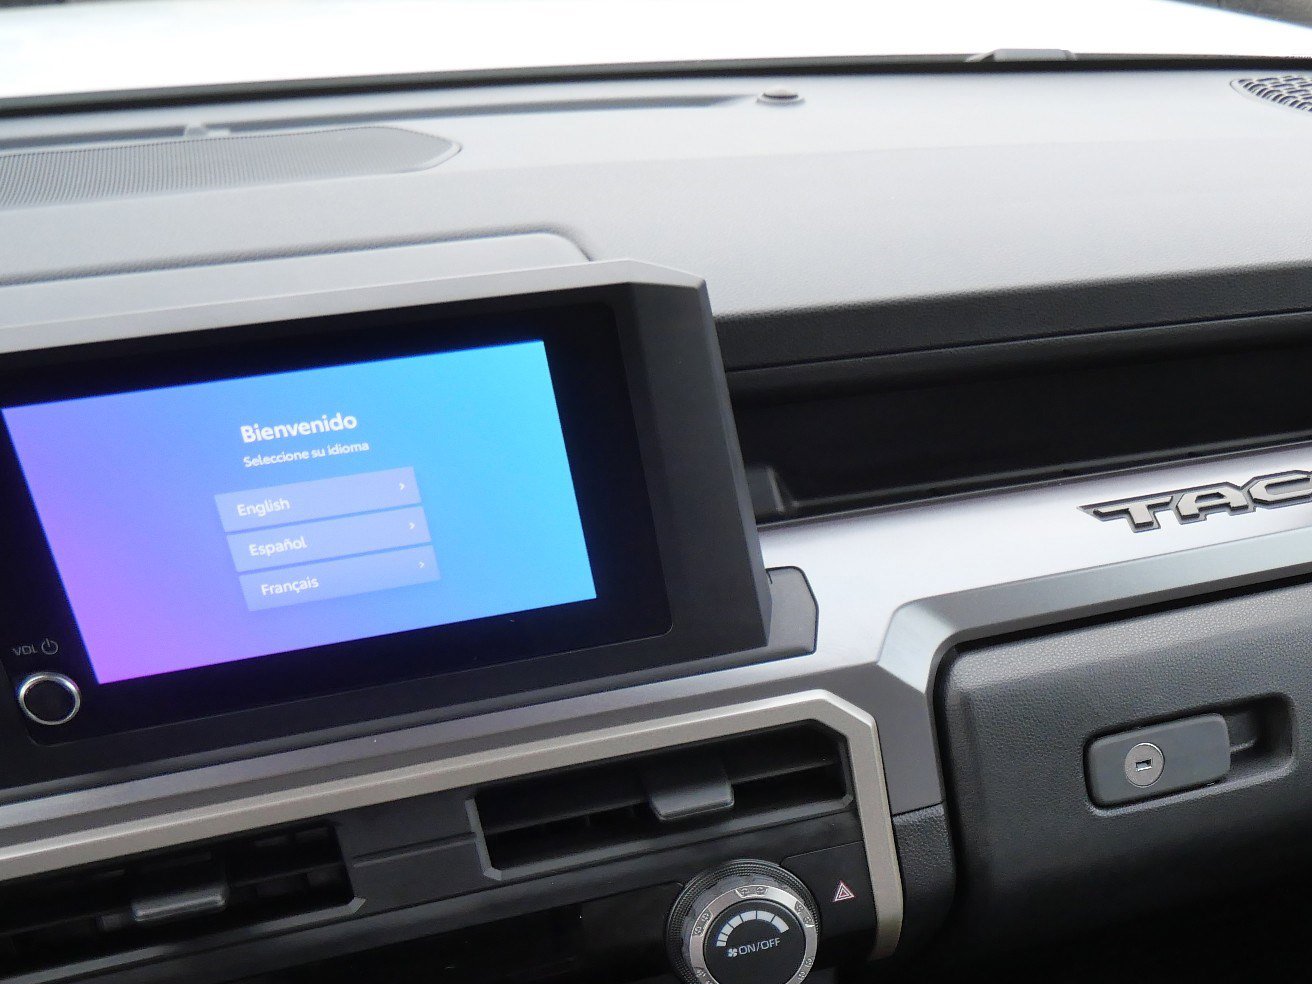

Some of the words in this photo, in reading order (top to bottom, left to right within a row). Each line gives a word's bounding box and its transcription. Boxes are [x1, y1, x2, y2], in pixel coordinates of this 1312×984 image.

[240, 412, 358, 443] Bienvenido
[243, 451, 310, 468] Seleccione
[311, 448, 326, 459] su
[327, 441, 370, 456] idioma
[236, 498, 291, 518] English
[249, 536, 308, 557] Español
[261, 576, 320, 597] Français
[12, 644, 38, 656] VOL
[738, 937, 781, 956] ON/OFF
